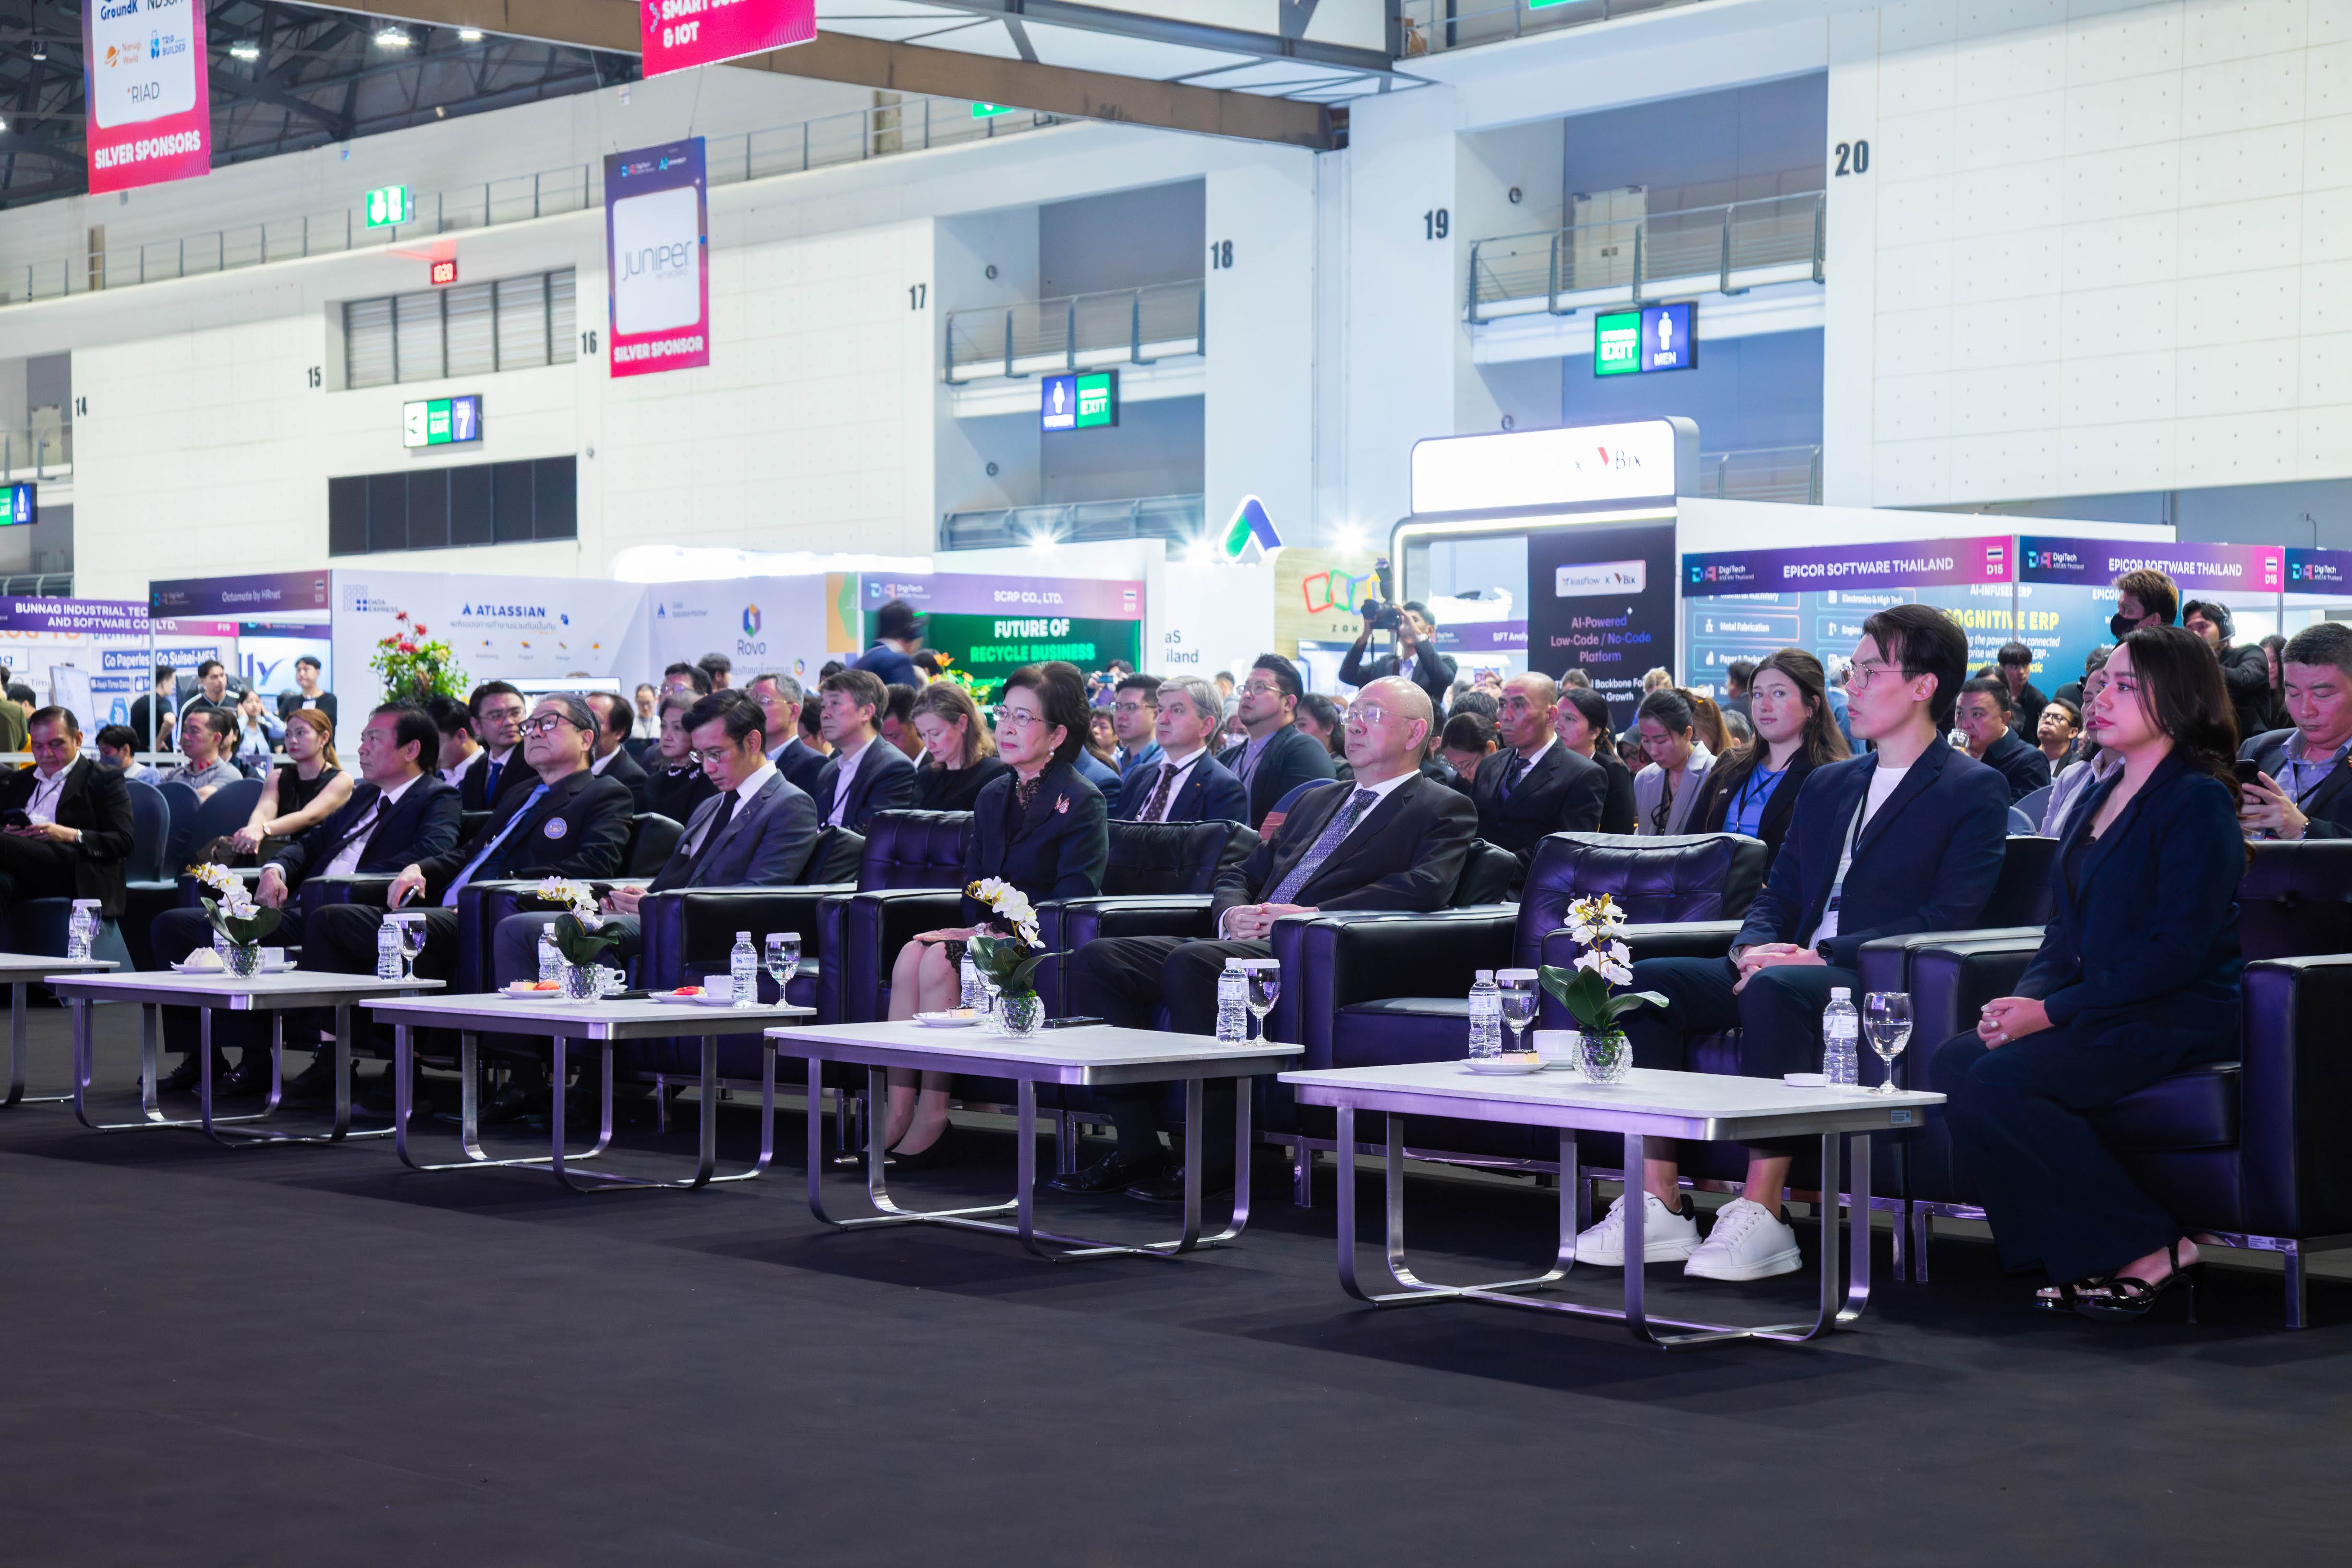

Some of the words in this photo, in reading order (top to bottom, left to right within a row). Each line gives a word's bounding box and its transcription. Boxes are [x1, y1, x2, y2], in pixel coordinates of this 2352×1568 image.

[664, 28, 673, 48] &
[675, 21, 699, 45] IOT
[132, 82, 160, 103] RIAD
[95, 143, 134, 169] SILVER
[135, 130, 201, 162] SPONSORS
[1835, 140, 1869, 176] 20
[1423, 207, 1449, 240] 19
[1210, 240, 1233, 269] 18
[909, 283, 926, 310] 17
[581, 330, 597, 354] 16
[614, 341, 651, 363] SILVER
[651, 336, 703, 359] SPONSOR
[1600, 340, 1636, 361] EXIT
[1654, 351, 1676, 366] MEN
[308, 366, 321, 388] 15
[75, 396, 87, 416] 14
[1080, 398, 1107, 415] EXIT
[457, 409, 470, 439] 7
[2053, 552, 2077, 562] DigiTech
[1719, 565, 1746, 575] DigiTech
[1783, 564, 1825, 578] EPICOR
[1827, 560, 1891, 576] SOFTWARE
[1893, 557, 1953, 573] THAILAND
[1987, 564, 2003, 575] D15
[2109, 558, 2143, 572] EPICOR
[2197, 562, 2242, 576] THAILAND
[2315, 565, 2336, 574] DigiTech
[1571, 576, 1600, 585] kissflow
[994, 591, 1020, 602] SCRP
[1043, 592, 1063, 604] LTD.
[1842, 594, 1872, 604] Electronics
[15, 602, 62, 615] BUNNAG
[63, 604, 126, 617] INDUSTRIAL
[127, 607, 149, 617] TEC
[476, 605, 546, 617] ATLASSIAN
[48, 616, 72, 627] AND
[73, 618, 132, 629] SOFTWARE
[156, 620, 178, 631] LTD.
[994, 619, 1048, 638] FUTURE
[1049, 618, 1070, 636] OF
[1571, 615, 1627, 629] AI-Powered
[1720, 622, 1736, 632] Metal
[1736, 622, 1770, 633] Fabrication
[2029, 611, 2060, 631] ERP
[1493, 632, 1508, 642] SIFT
[1551, 633, 1599, 647] Low-Code
[1600, 632, 1606, 646] /
[1608, 630, 1651, 644] No-Code
[1975, 634, 1986, 645] the
[1986, 636, 2008, 647] power
[2027, 636, 2060, 647] connected
[737, 639, 766, 655] Rovo
[970, 645, 1029, 663] RECYCLE
[1031, 643, 1095, 661] BUSINESS
[105, 654, 115, 667] Go
[156, 652, 168, 666] Go
[1579, 650, 1621, 663] Platform
[1596, 679, 1632, 689] Backbone
[1606, 692, 1634, 703] Growth
